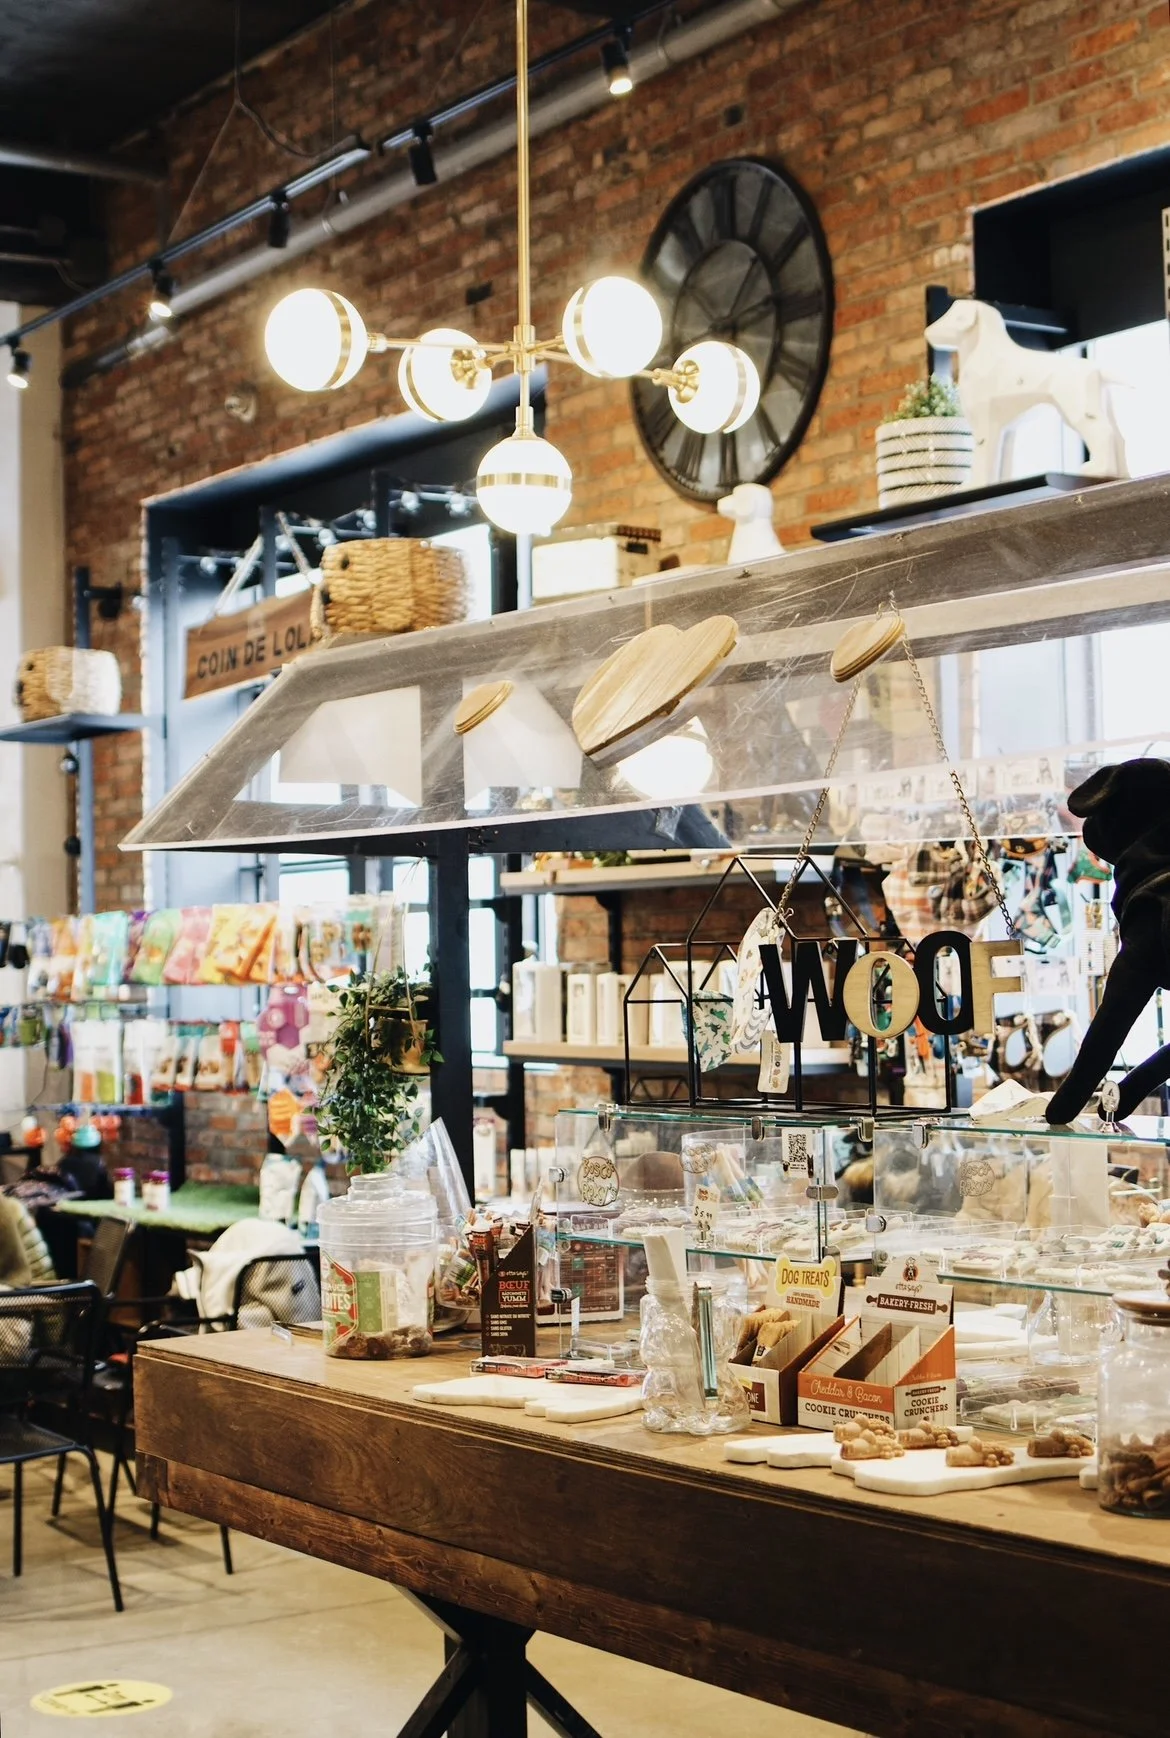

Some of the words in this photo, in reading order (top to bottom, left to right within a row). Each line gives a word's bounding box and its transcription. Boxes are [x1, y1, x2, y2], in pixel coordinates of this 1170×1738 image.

[196, 645, 237, 679] COIN
[244, 634, 266, 667] DE
[273, 624, 313, 655] LOL
[758, 930, 1025, 1043] WOOF
[498, 1280, 531, 1290] BŒUF
[782, 1268, 799, 1285] DOG
[802, 1269, 830, 1288] TREATS
[786, 1295, 820, 1309] HANDMADE
[880, 1297, 934, 1311] BAKERY-FRESH
[810, 1379, 845, 1398] Cheddar
[846, 1385, 853, 1399] &
[854, 1386, 883, 1404] Bacon
[911, 1396, 940, 1407] COOKIE
[804, 1402, 837, 1416] COOKIE
[904, 1403, 949, 1417] CRUNCHERS
